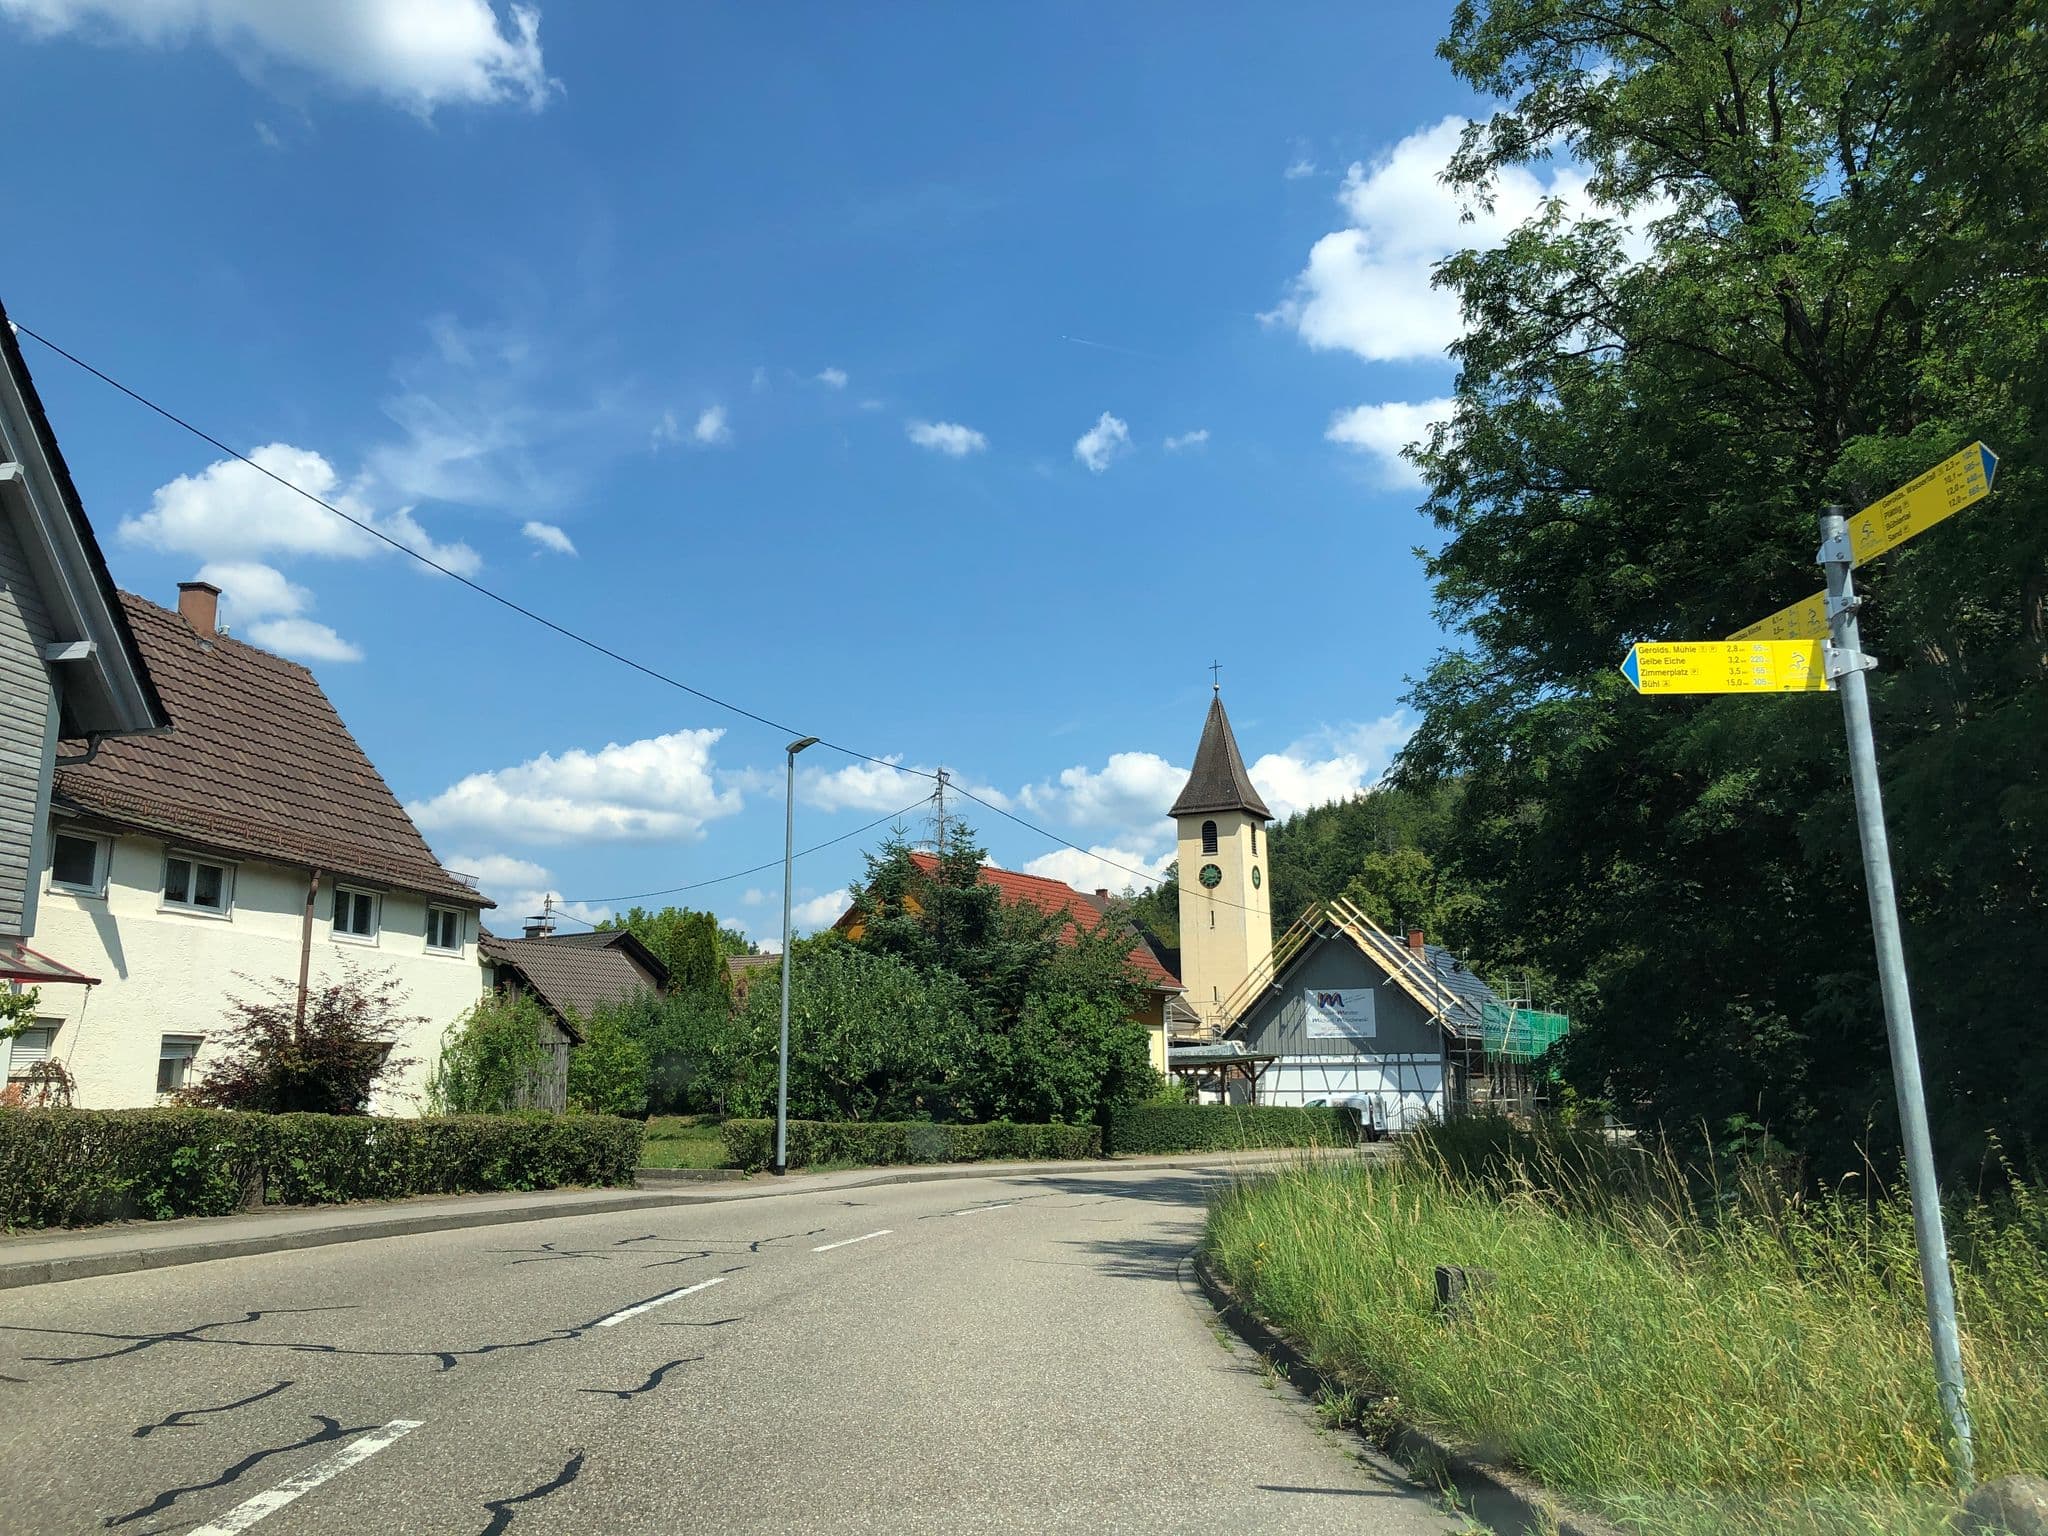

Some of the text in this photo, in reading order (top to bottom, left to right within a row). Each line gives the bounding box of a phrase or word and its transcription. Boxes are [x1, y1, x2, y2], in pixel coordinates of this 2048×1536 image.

[1906, 472, 1936, 493] Wasserfall
[1888, 529, 1902, 542] Sand
[1638, 646, 1671, 654] Gerolds.
[1726, 644, 1738, 653] 2,8
[1639, 657, 1662, 665] Gelbe
[1664, 657, 1686, 665] Eiche
[1728, 656, 1740, 664] 3,2
[1640, 669, 1688, 677] Zimmerplatz
[1729, 667, 1741, 676] 3,5
[1641, 680, 1660, 688] Bühl
[1726, 678, 1742, 687] 15,0
